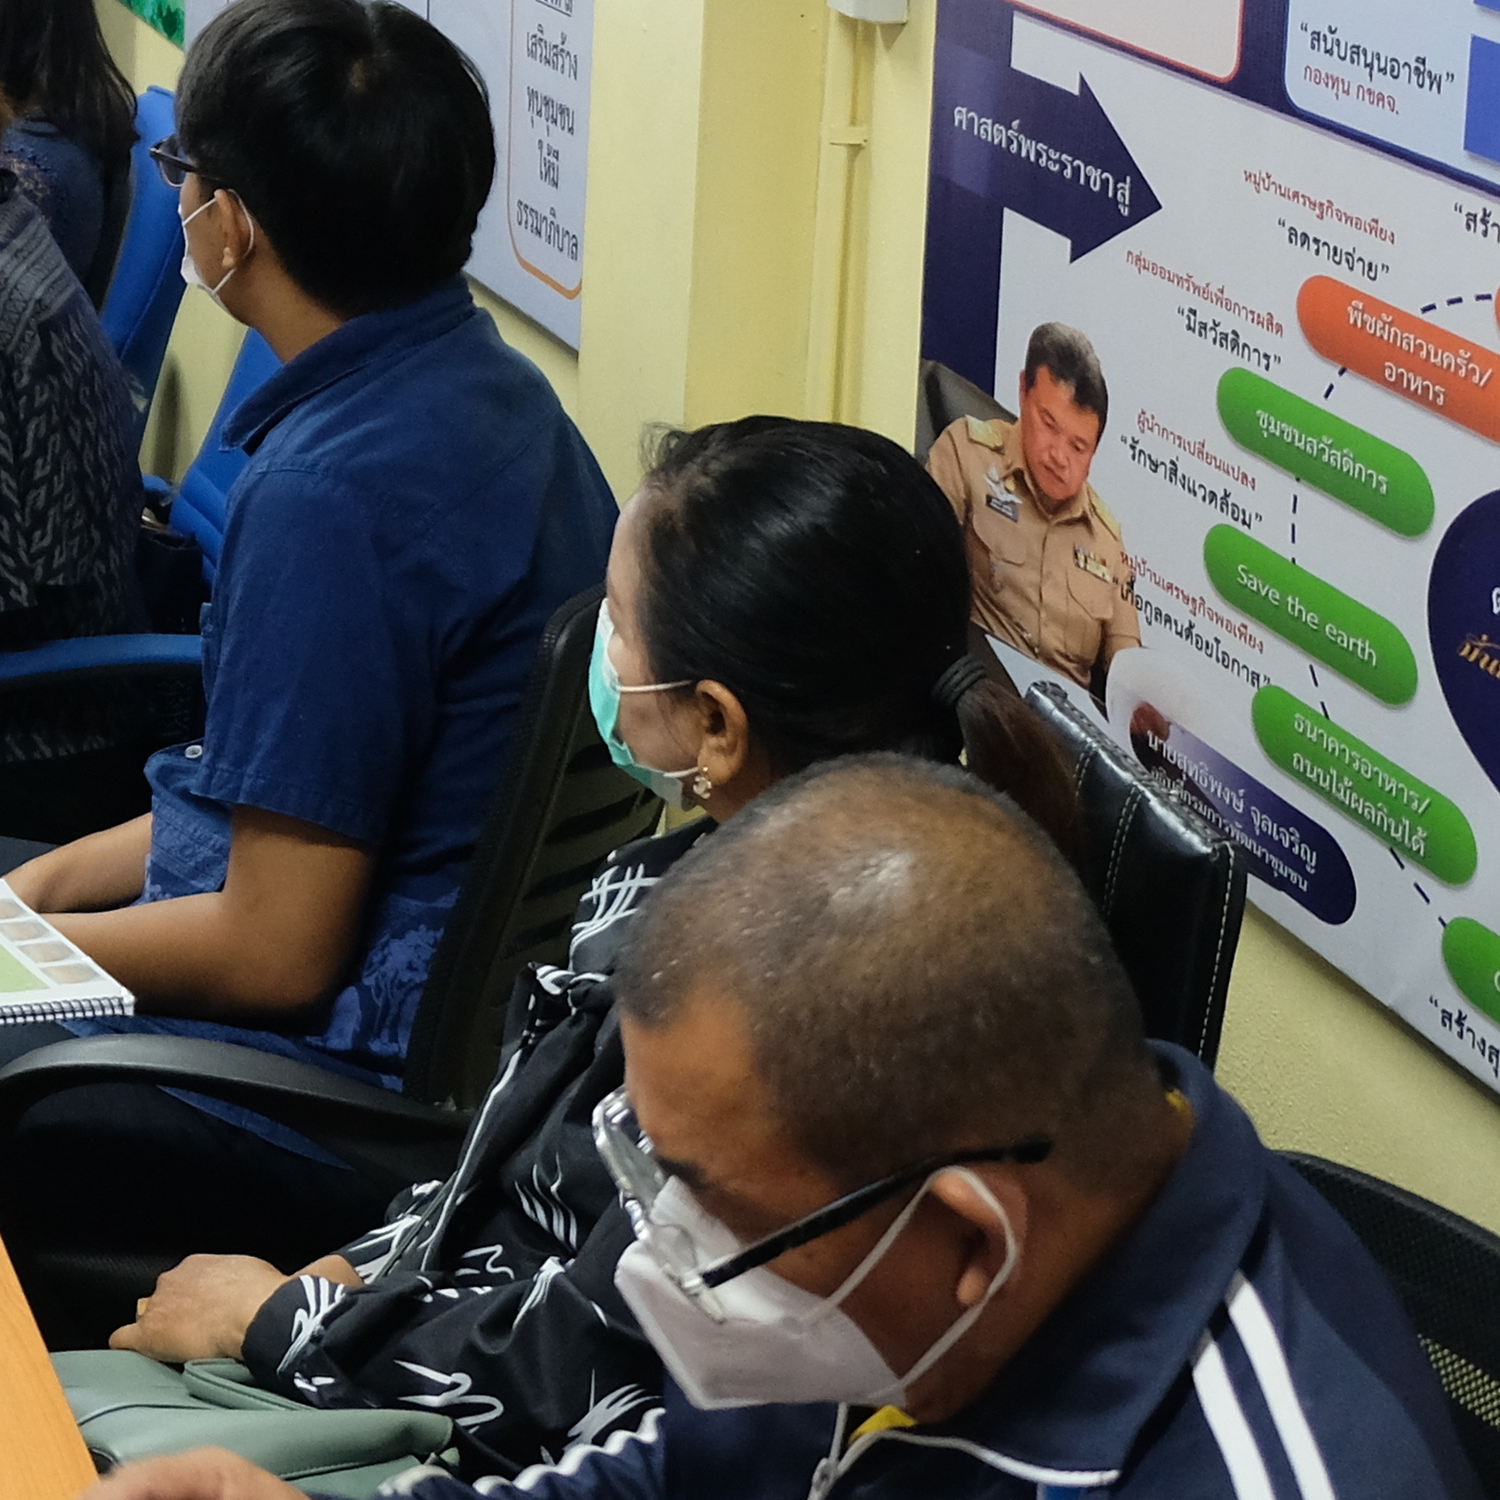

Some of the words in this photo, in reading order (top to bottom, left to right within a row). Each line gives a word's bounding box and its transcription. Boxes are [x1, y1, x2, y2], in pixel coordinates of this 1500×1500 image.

[525, 23, 579, 82] เสริมสร้าง
[1299, 21, 1456, 95] “สนับสนุนอาชีพ”
[1303, 64, 1351, 100] กองทุน
[1356, 83, 1400, 116] กขคจ.
[526, 84, 576, 138] ทุนชุมชน
[538, 138, 560, 191] ให้มี
[515, 198, 580, 263] ธรรมาภิบาล
[1242, 167, 1397, 247] หมู่บ้านเศรษฐกิจพอเพียง
[1276, 217, 1391, 283] “ลดรายจ่าย”
[1125, 247, 1285, 339] กลุ่มออมทรัพย์เพื่อการผลิต
[1175, 305, 1283, 372] “มีสวัสดิการ”
[1346, 299, 1493, 390] พืชผักสวนครัว/
[1383, 360, 1446, 407] อาหาร
[1120, 433, 1263, 531] “รักษาสิ่งแวดล้อม”
[1136, 407, 1257, 492] ผู้นำการเปลี่ยนแปลง
[1256, 407, 1390, 497] ชุมชนสวัสดิการ
[1119, 550, 1265, 655] หมู่บ้านเศรษฐกิจพอเพียง
[1236, 563, 1281, 606] Save
[1286, 588, 1319, 630] the
[1325, 619, 1378, 668] earth
[1146, 728, 1246, 816] นายสุทธิพงษ์
[1249, 803, 1319, 875] จุลเจริญ
[1291, 749, 1427, 858] ถนนไม้ผลกินได้
[1292, 711, 1434, 817] ธนาคารอาหาร/
